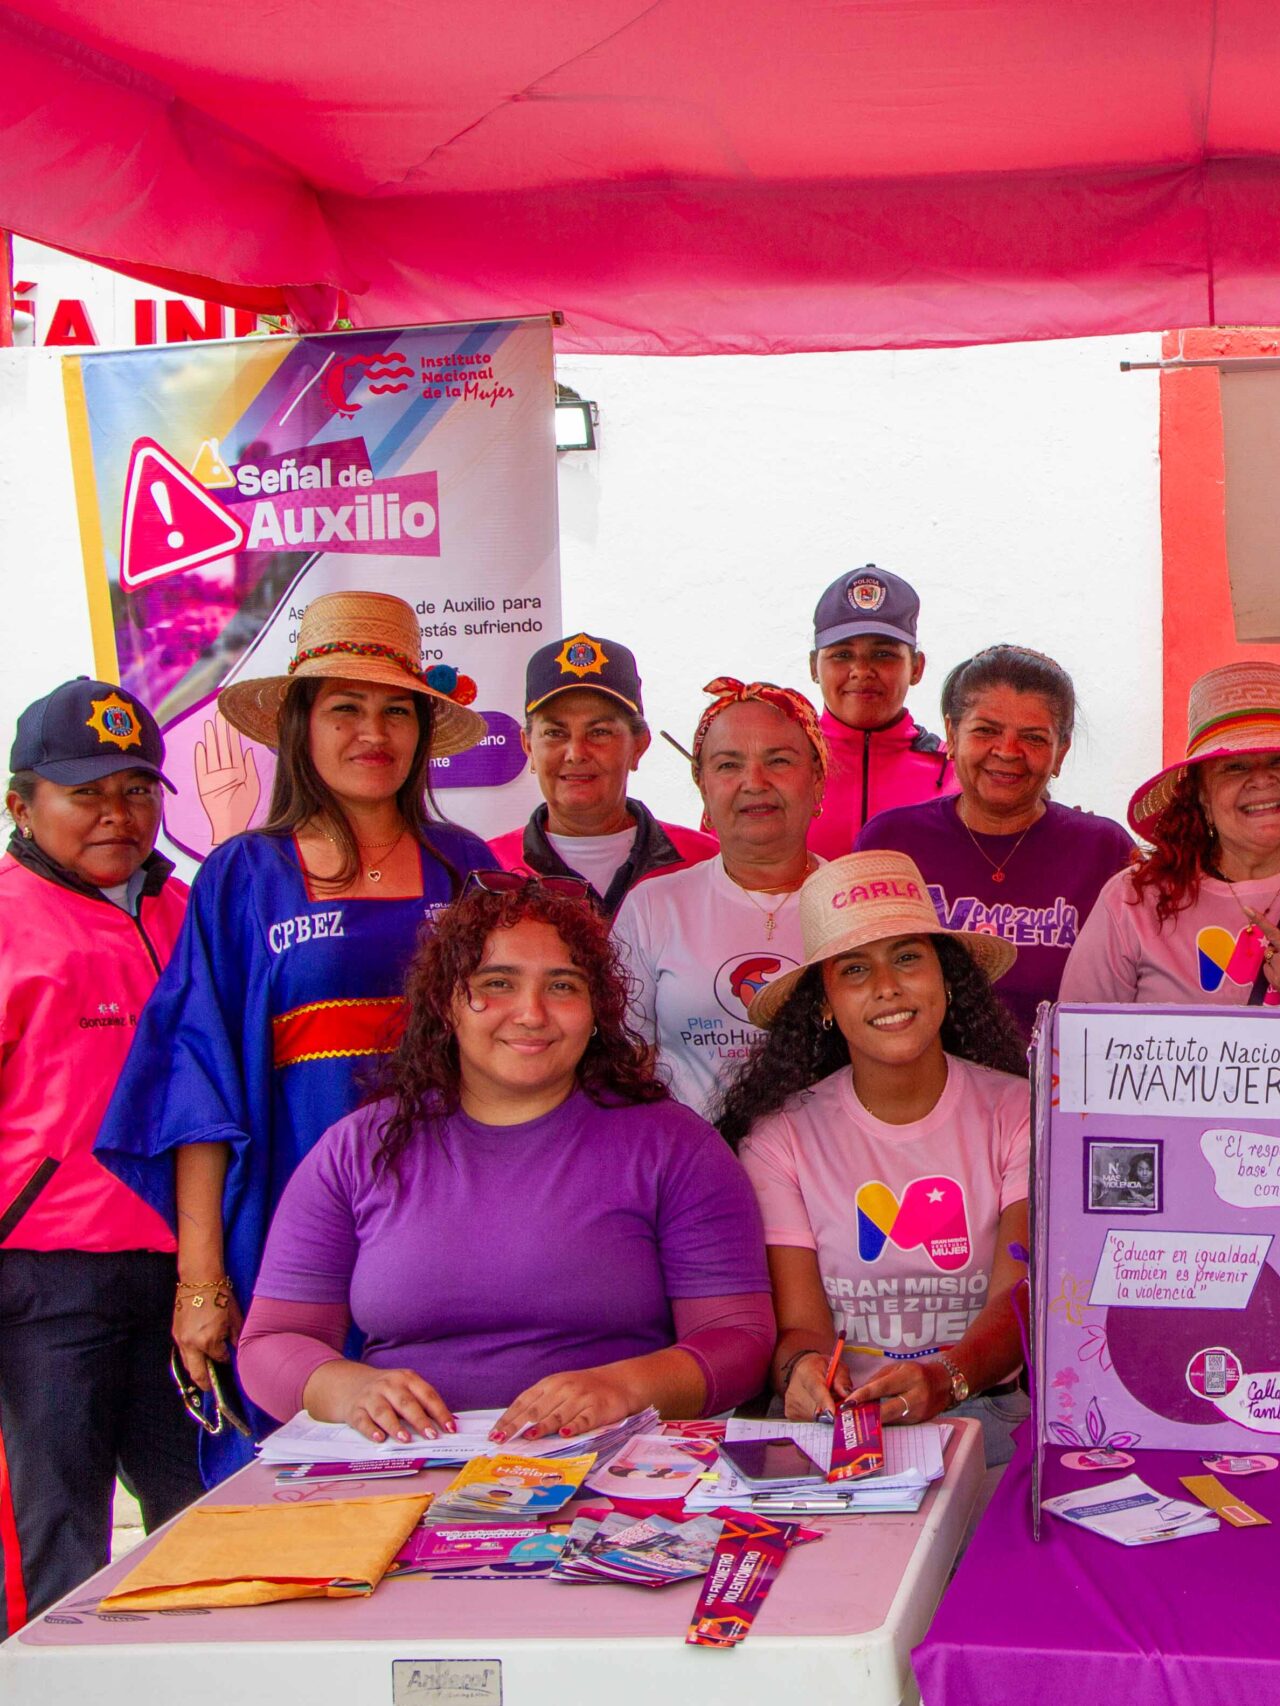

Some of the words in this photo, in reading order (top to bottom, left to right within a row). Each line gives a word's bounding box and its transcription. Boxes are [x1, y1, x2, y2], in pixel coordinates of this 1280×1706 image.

[421, 353, 491, 368] Instituto
[422, 368, 493, 383] Nacional
[422, 386, 441, 399] de
[446, 386, 461, 398] la
[464, 381, 514, 407] Mujer
[236, 458, 331, 496] Señal
[338, 465, 373, 487] de
[246, 493, 436, 550] Auxilio
[416, 600, 436, 616] de
[443, 596, 495, 614] Auxilio
[503, 596, 542, 611] para
[464, 620, 543, 637] sufriendo
[832, 881, 922, 909] CARLA
[269, 911, 345, 954] CPBEZ
[687, 1017, 724, 1031] Plan
[1106, 1035, 1209, 1063] Instituto
[1238, 1158, 1268, 1177] base
[932, 1246, 968, 1257] MUJER
[1172, 1249, 1187, 1264] en
[823, 1276, 899, 1297] GRAN
[904, 1270, 991, 1297] MISIÓ
[1176, 1269, 1189, 1281] es
[1195, 1268, 1248, 1288] prevenir
[1117, 1283, 1129, 1299] la
